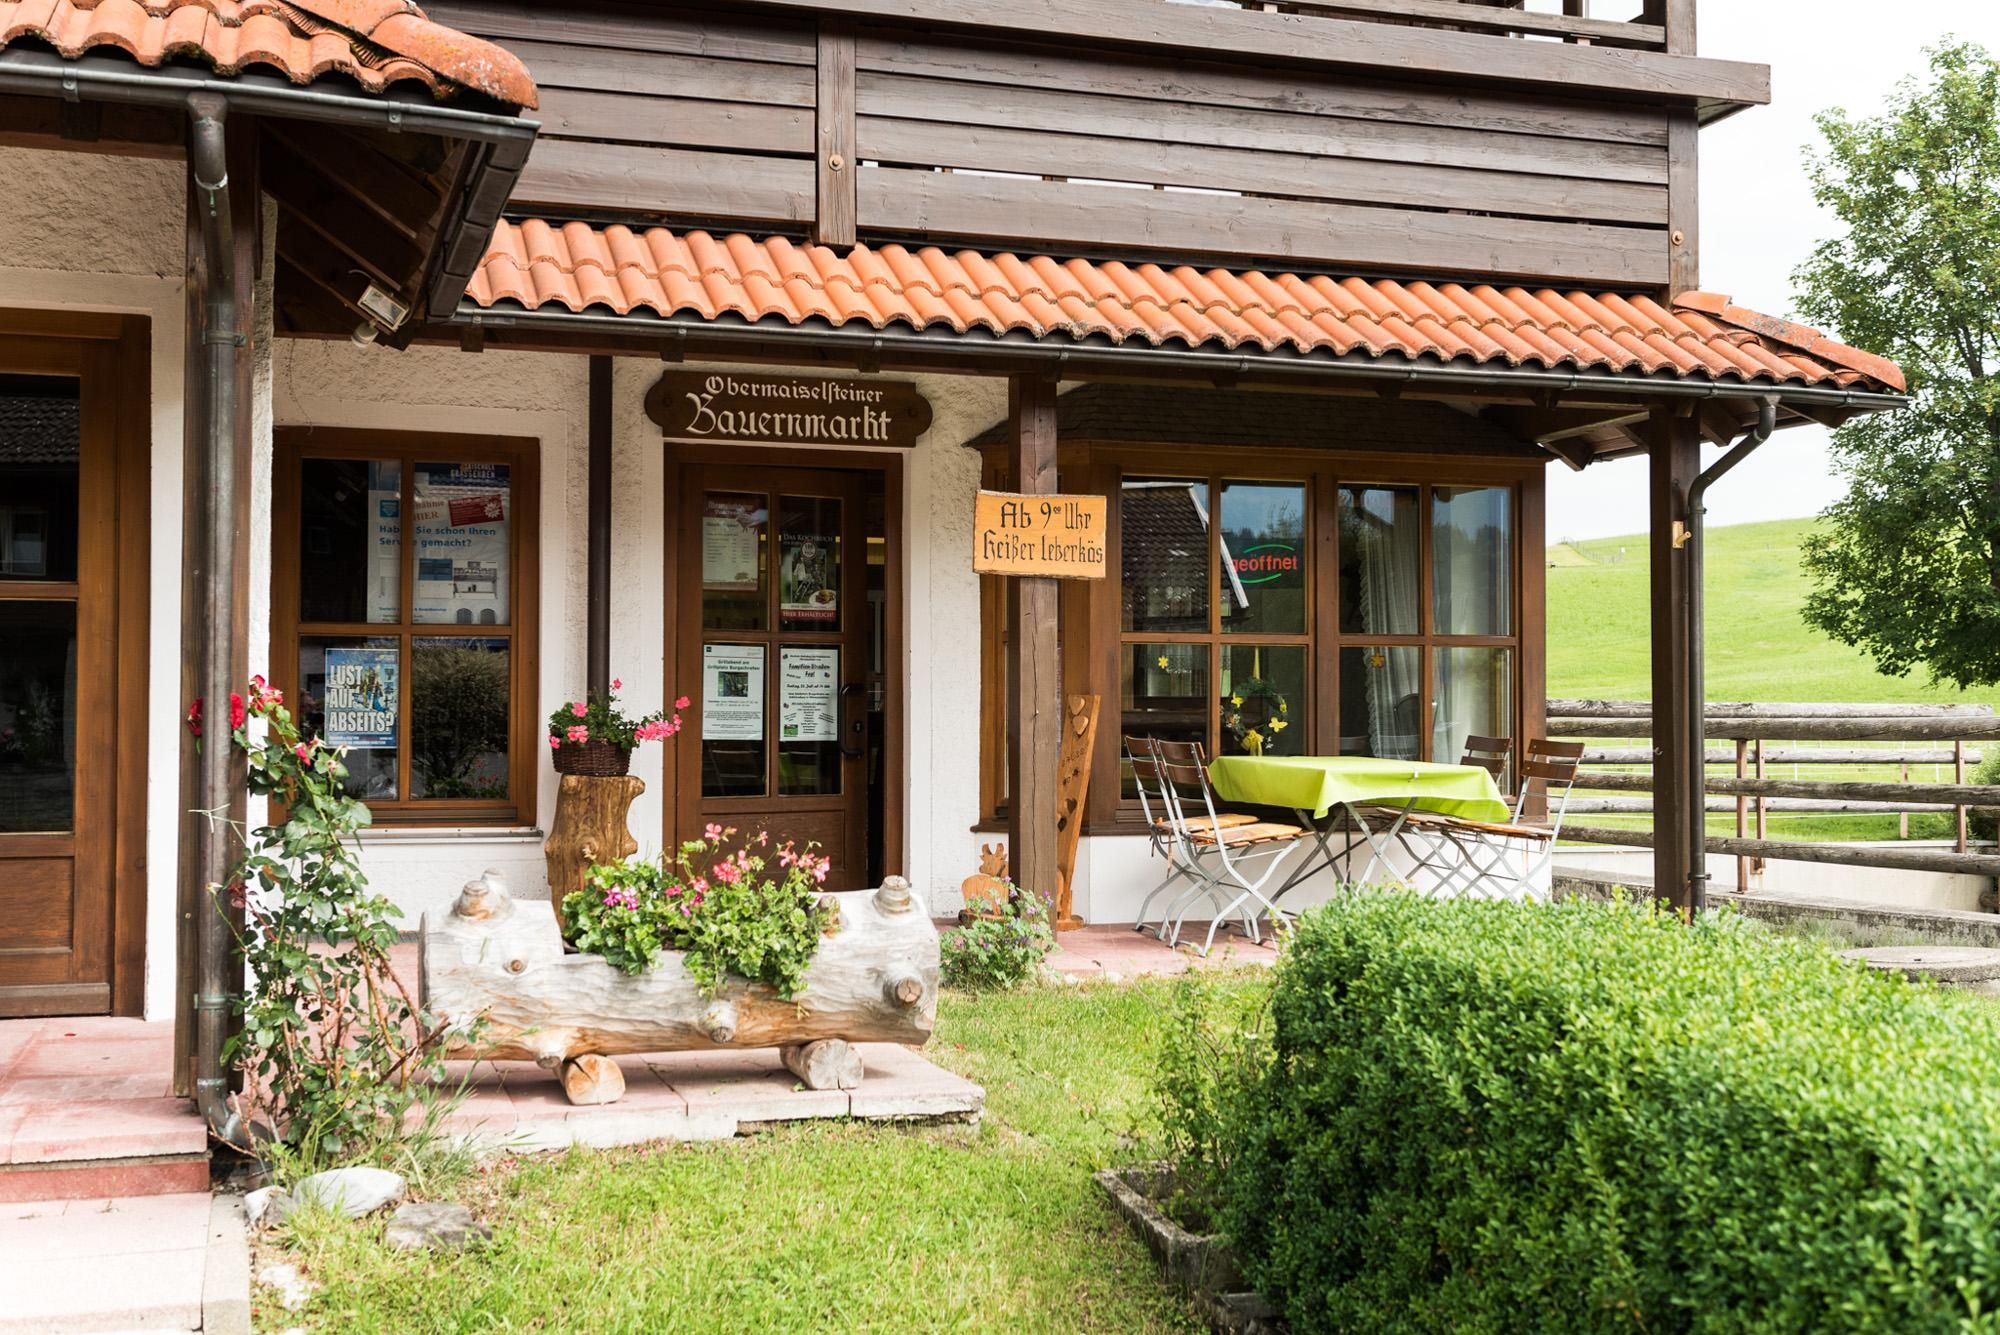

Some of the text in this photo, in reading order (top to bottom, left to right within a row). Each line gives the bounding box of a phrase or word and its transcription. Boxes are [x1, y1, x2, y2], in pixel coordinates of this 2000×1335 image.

[685, 391, 892, 441] Bauernmarkt
[1000, 501, 1031, 529] Ab
[1064, 502, 1092, 533] Uhr
[416, 526, 432, 535] Sie
[435, 526, 465, 535] schon
[468, 526, 496, 536] Ihren
[421, 538, 472, 548] gemacht?
[330, 666, 363, 685] LUST
[330, 688, 355, 708] AUF
[328, 711, 395, 732] ABSEITS?
